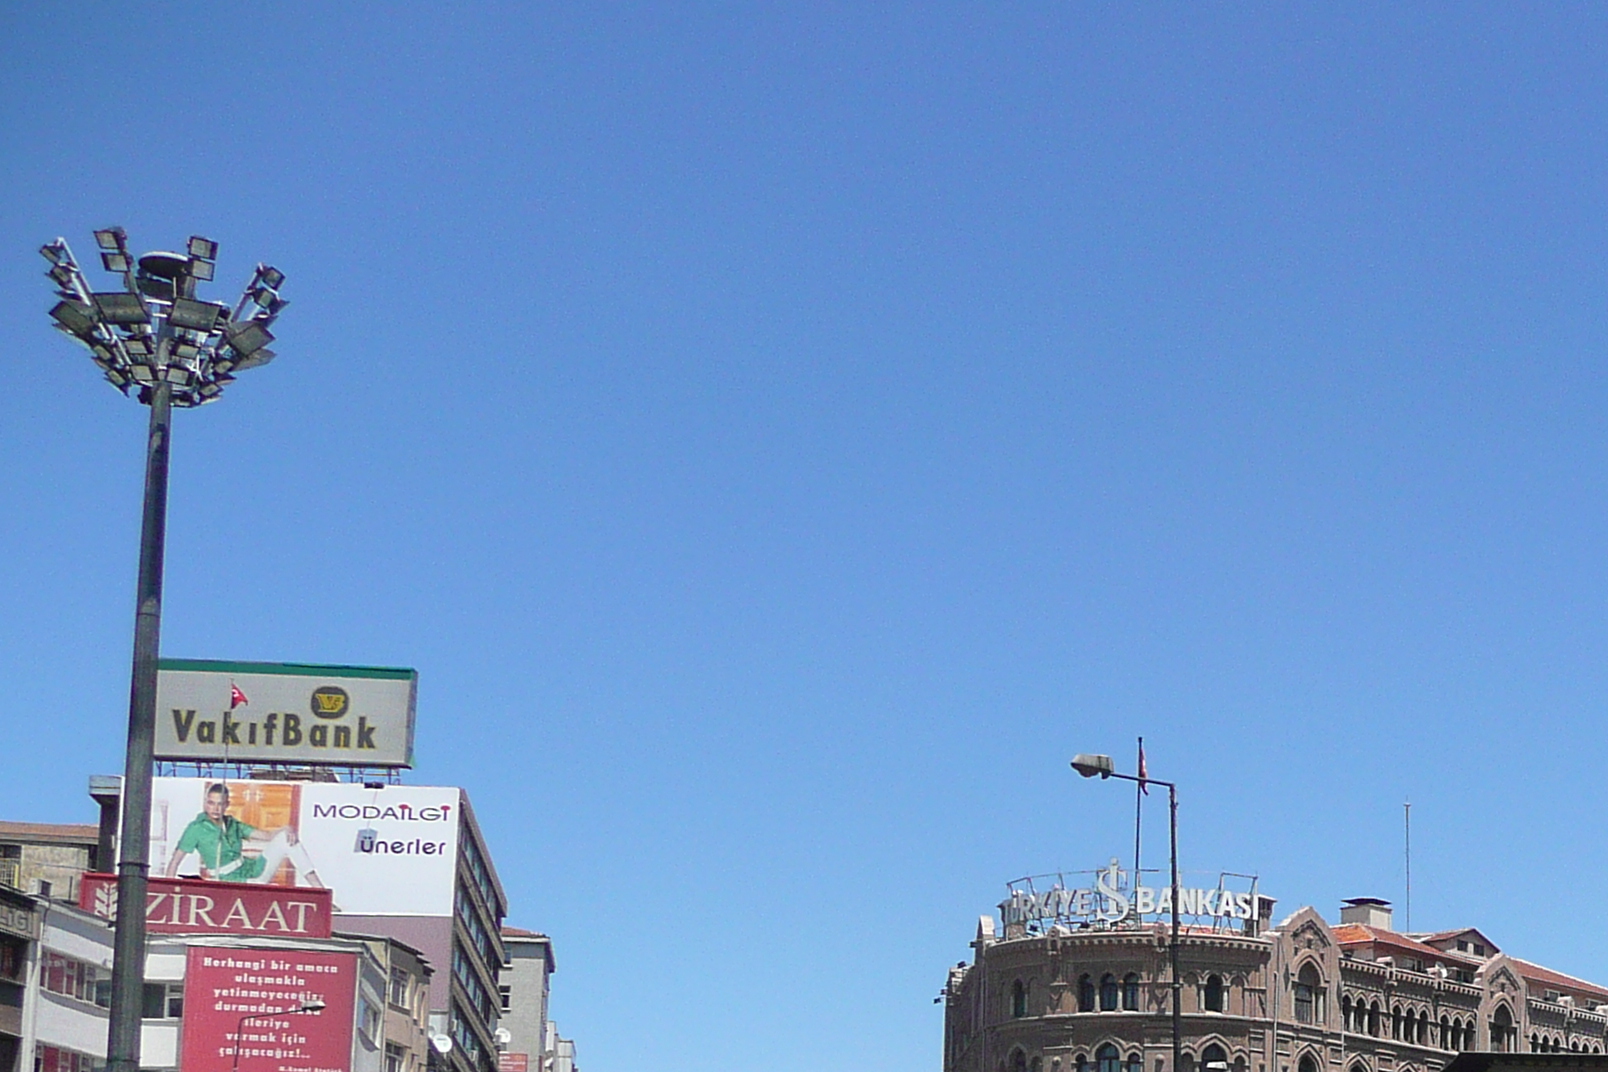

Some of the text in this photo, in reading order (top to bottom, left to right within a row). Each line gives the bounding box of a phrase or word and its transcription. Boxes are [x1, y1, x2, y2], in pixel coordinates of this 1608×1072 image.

[172, 709, 377, 749] VakıfBank
[360, 835, 446, 855] ünerler
[146, 886, 317, 933] ZİRAAT
[203, 957, 266, 971] Herhangi
[270, 960, 292, 971] bir
